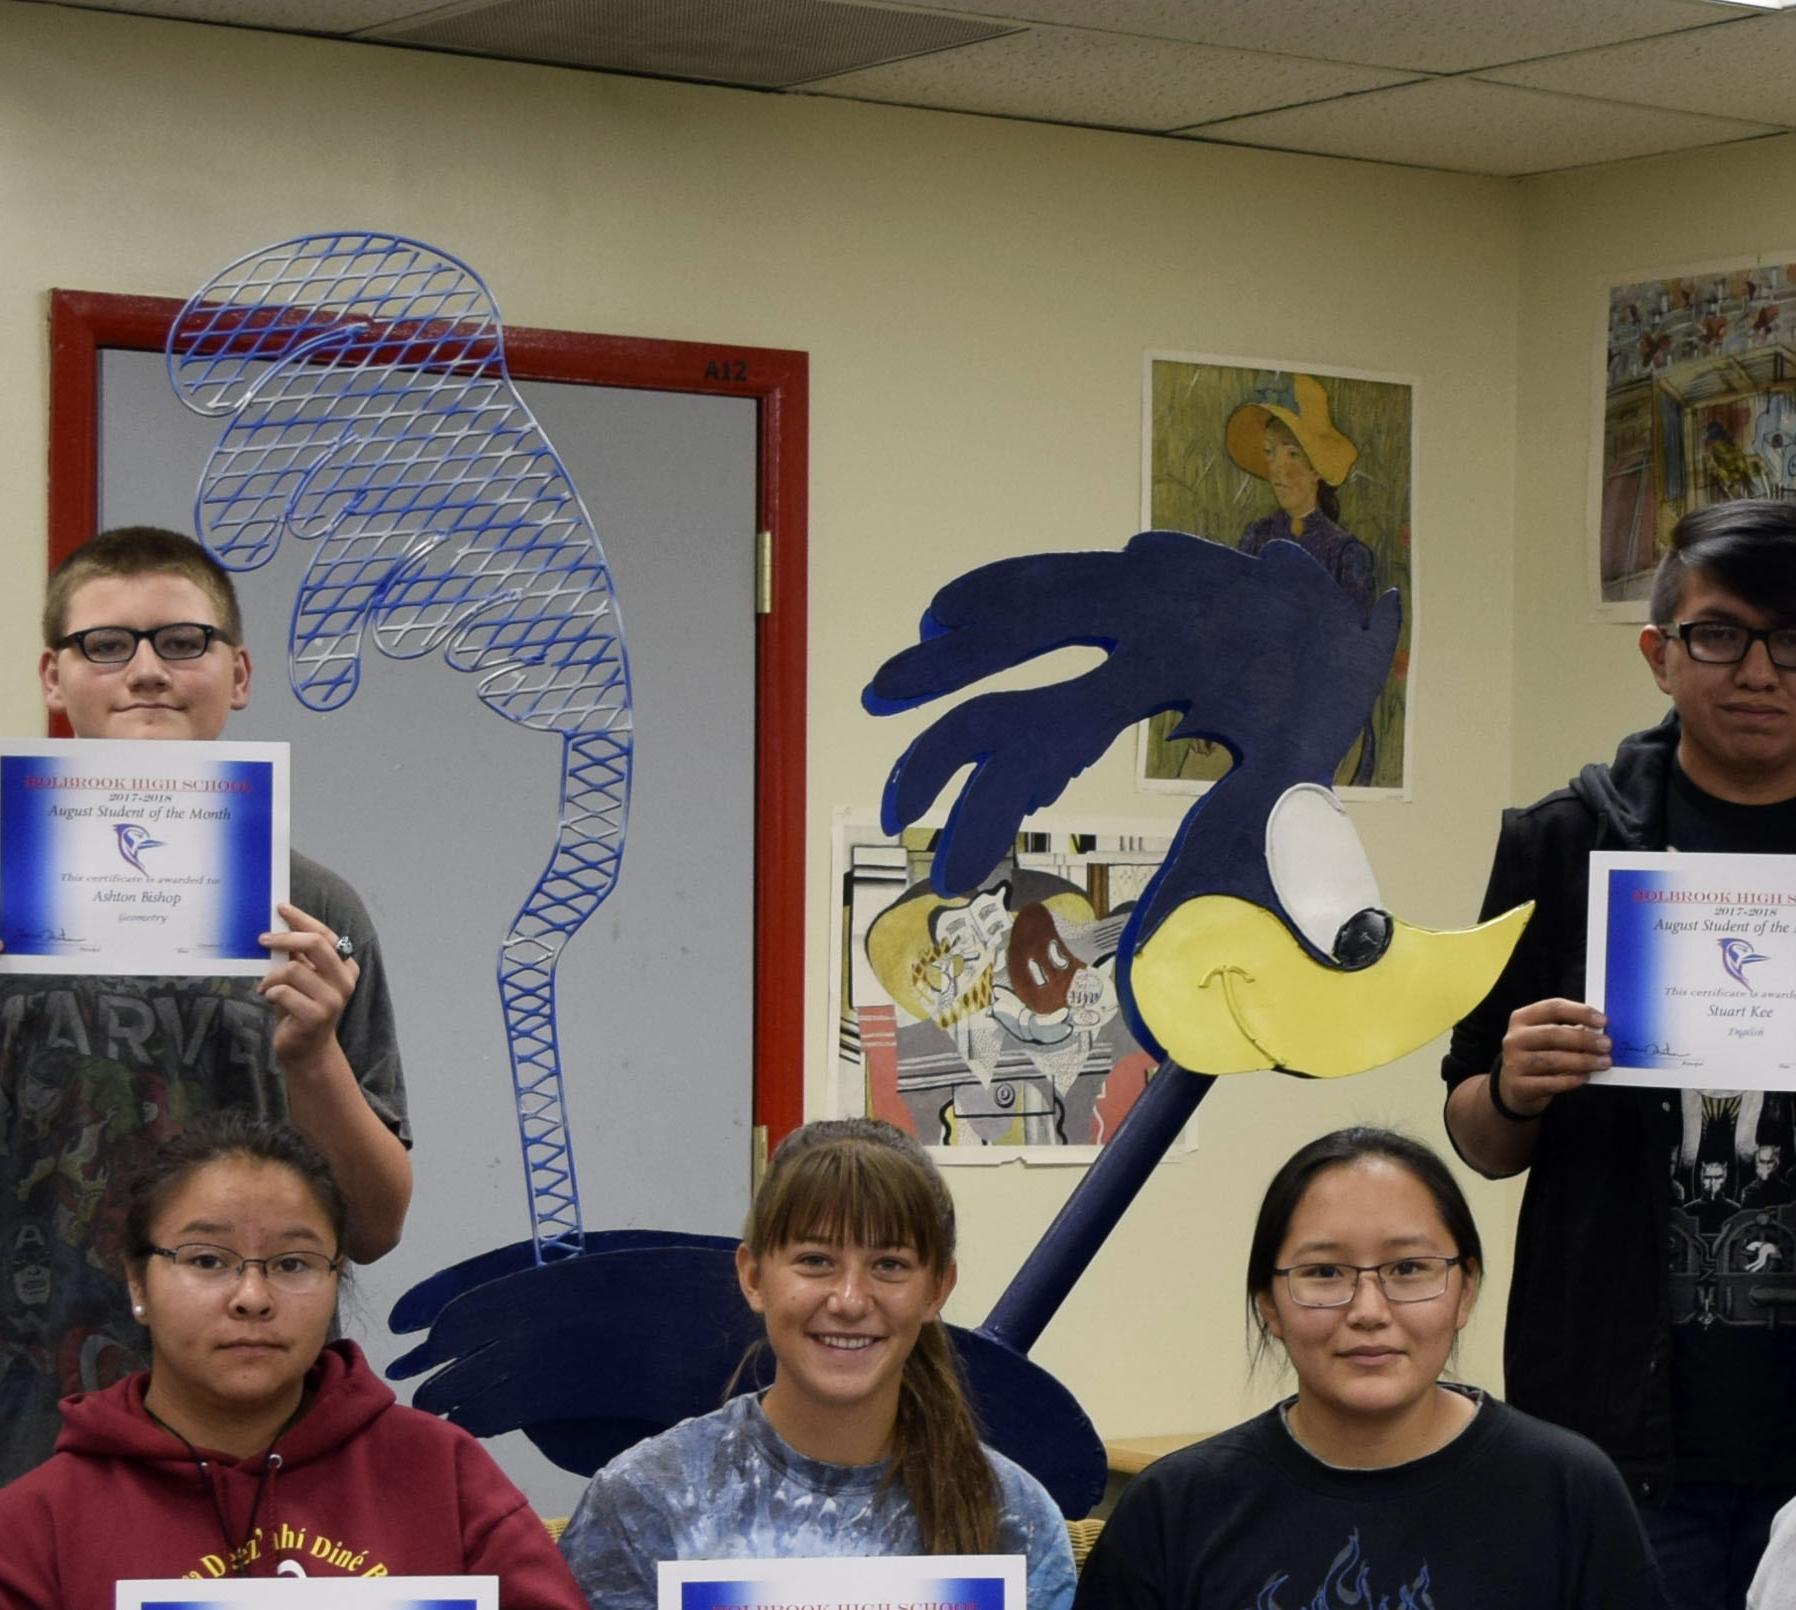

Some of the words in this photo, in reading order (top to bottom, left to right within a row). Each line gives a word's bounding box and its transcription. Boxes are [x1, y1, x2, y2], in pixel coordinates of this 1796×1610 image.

[705, 360, 749, 382] A12
[131, 778, 177, 790] HIGH
[107, 792, 173, 803] 2017-2018
[47, 803, 93, 821] August
[97, 804, 145, 818] Student
[148, 805, 164, 822] of
[165, 805, 185, 819] the
[188, 805, 232, 820] Month
[91, 889, 136, 903] Ashton
[141, 890, 182, 907] Bishop
[1736, 892, 1782, 904] HIGH
[1712, 906, 1778, 917] 2017-2018
[1653, 917, 1698, 935] August
[1702, 918, 1750, 933] Student
[1753, 919, 1769, 936] of
[1770, 920, 1790, 933] the
[1706, 1003, 1745, 1018] Stuart
